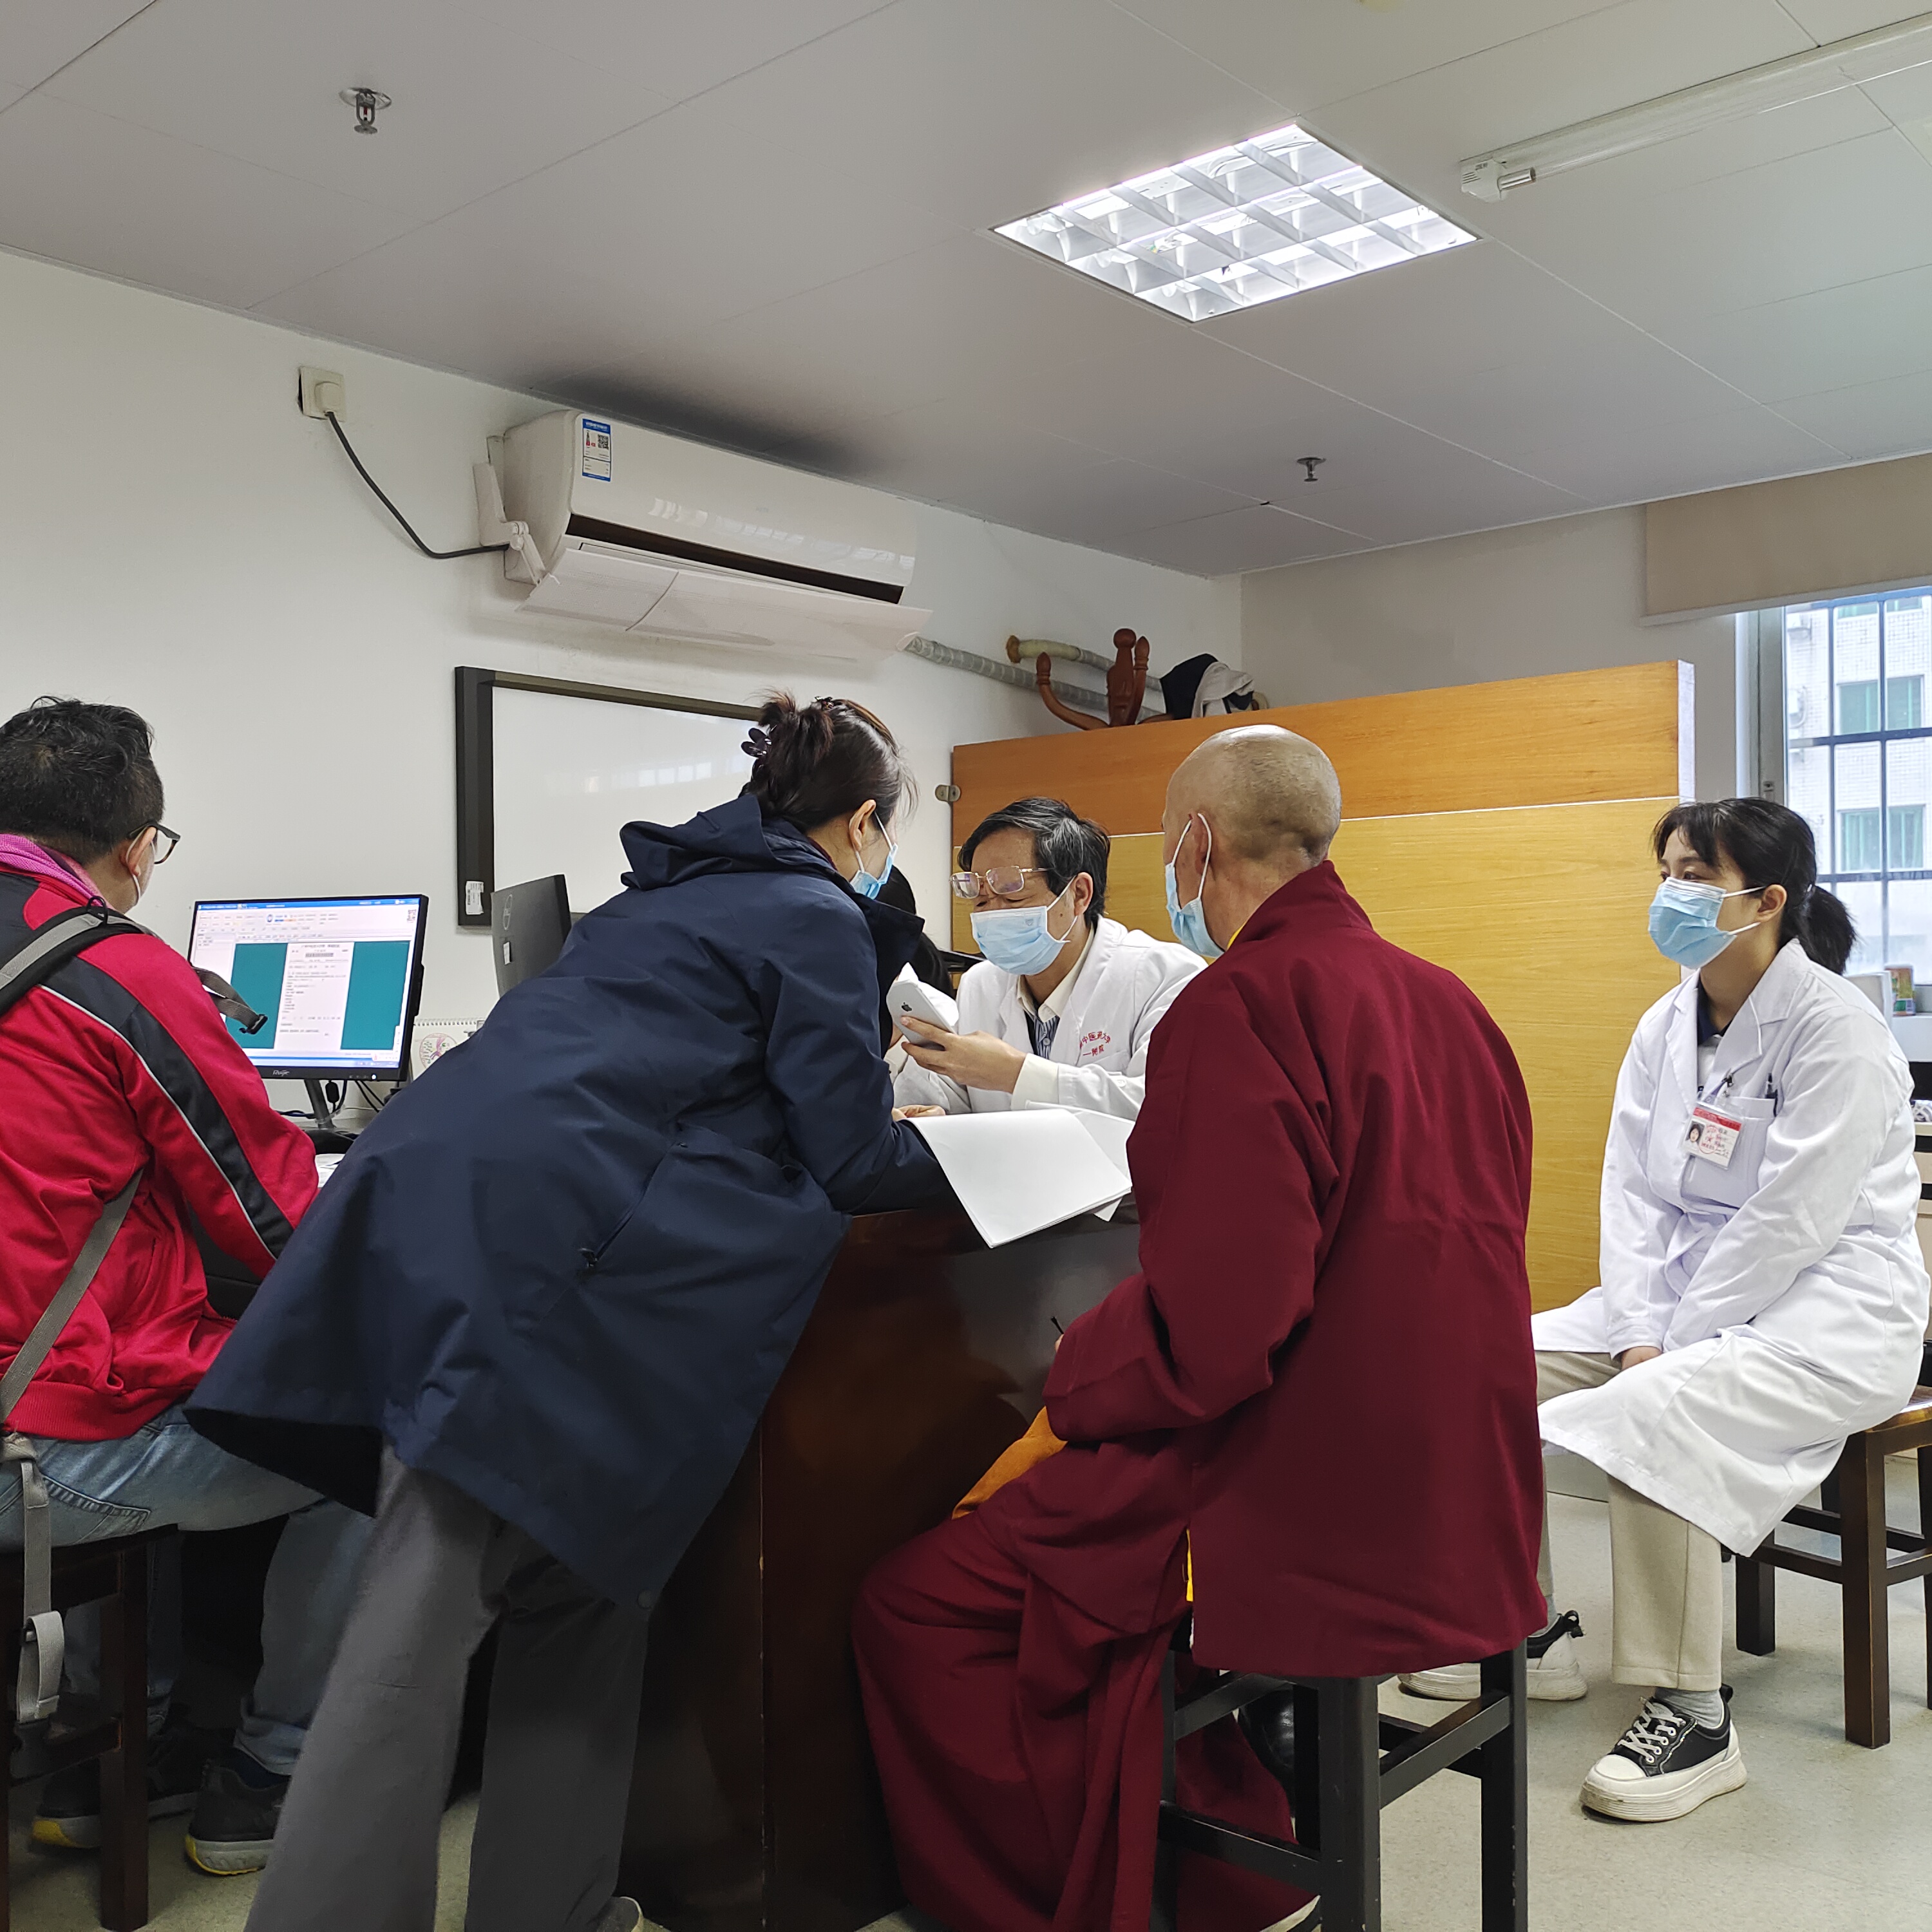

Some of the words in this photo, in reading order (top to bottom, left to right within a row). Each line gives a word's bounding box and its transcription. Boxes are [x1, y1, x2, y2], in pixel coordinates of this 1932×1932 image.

[1079, 1031, 1111, 1049] 中医药大学
